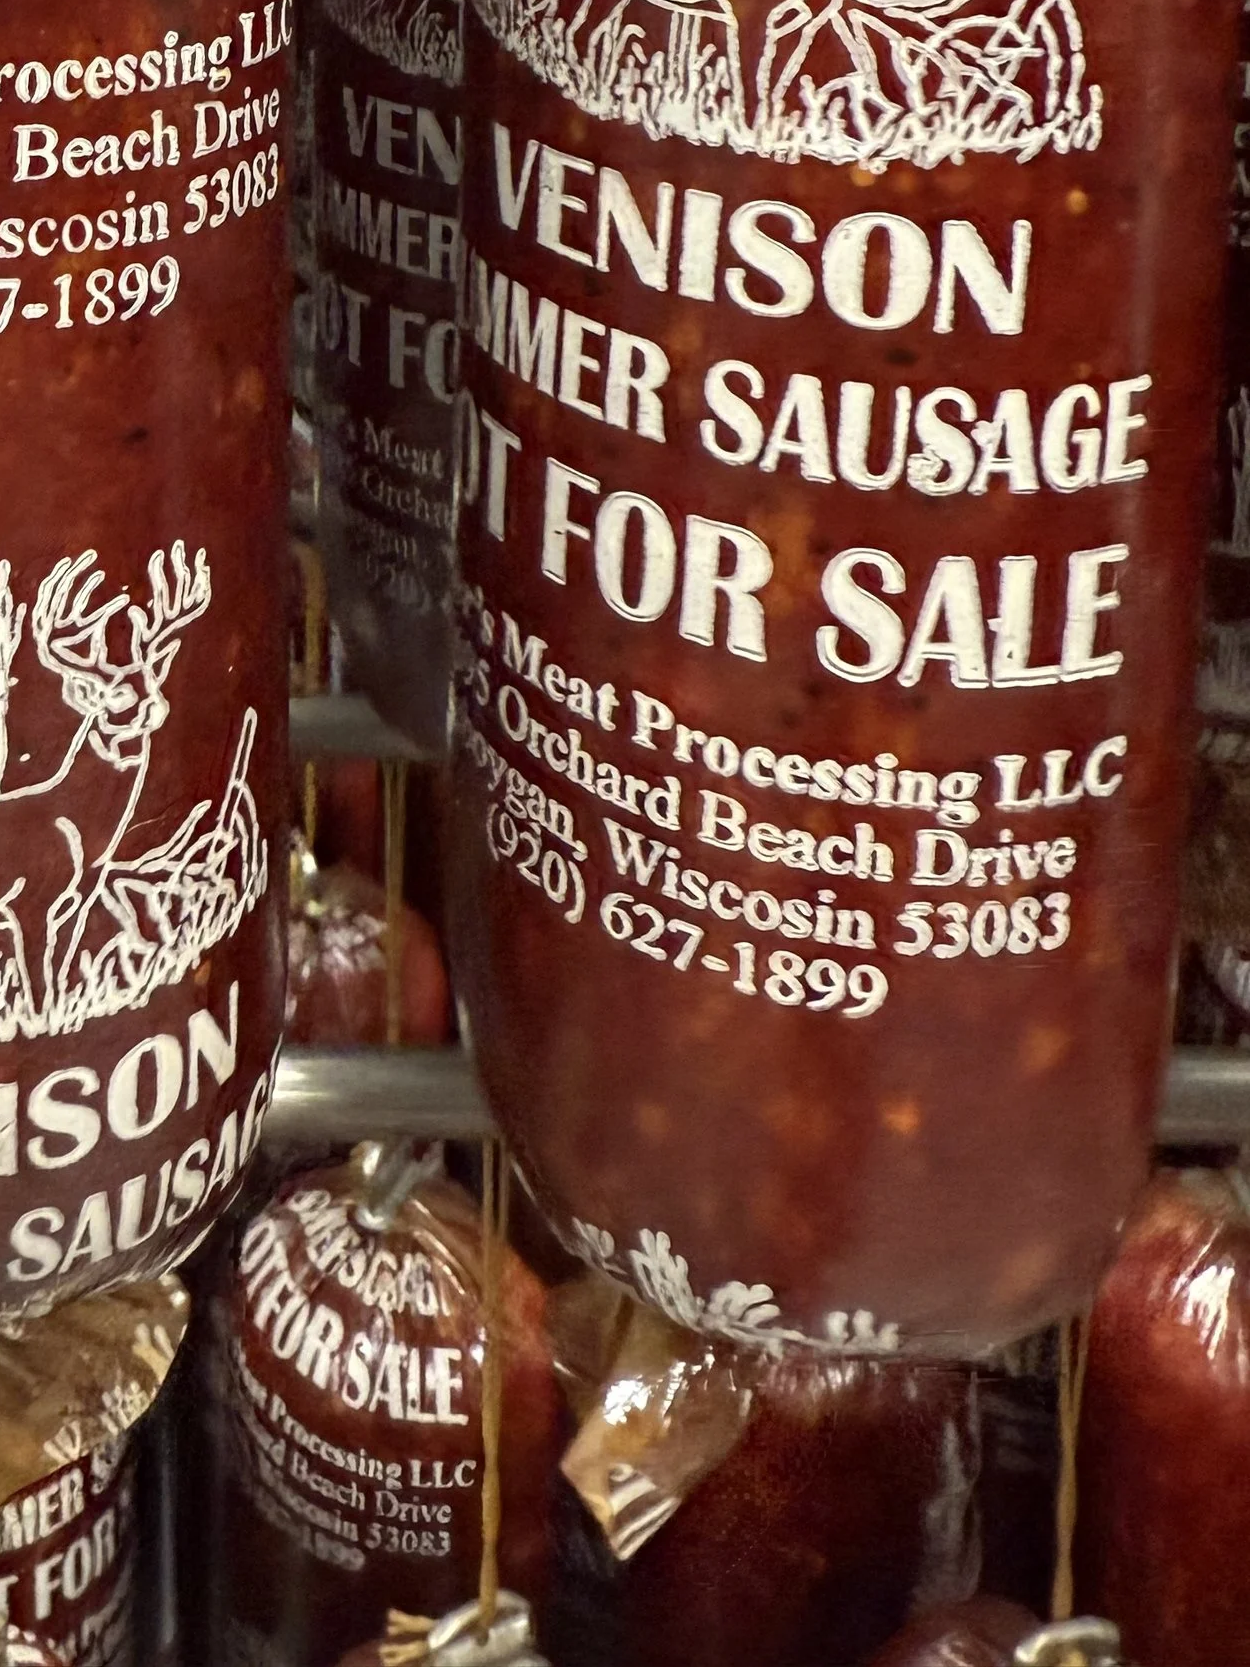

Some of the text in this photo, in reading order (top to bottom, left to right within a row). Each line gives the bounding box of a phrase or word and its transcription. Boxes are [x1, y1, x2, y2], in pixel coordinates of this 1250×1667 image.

[13, 110, 181, 184] Beach
[191, 86, 281, 160] Drive
[181, 144, 280, 236] 53083
[343, 86, 464, 185] VEN
[493, 122, 1033, 335] VENISON
[388, 304, 458, 405] FO
[699, 360, 1153, 496] SAUSAGE
[452, 386, 522, 541] OT
[541, 457, 774, 662] FOR
[815, 544, 1130, 689] SALE
[497, 684, 1078, 889] Orchard Beach Drive
[501, 609, 619, 732] Meat
[632, 690, 982, 828] Processing
[993, 736, 1128, 814] LLC
[486, 802, 890, 1020] (920) 627-1899
[602, 818, 876, 950] Wiscosin
[893, 892, 1072, 960] 53083
[6, 1034, 282, 1284] SAUSAG
[253, 1267, 346, 1390] FOR
[341, 1331, 470, 1426] SALE
[374, 1490, 453, 1525] Drive
[408, 1458, 478, 1490] LLC
[34, 1506, 118, 1621] FOR
